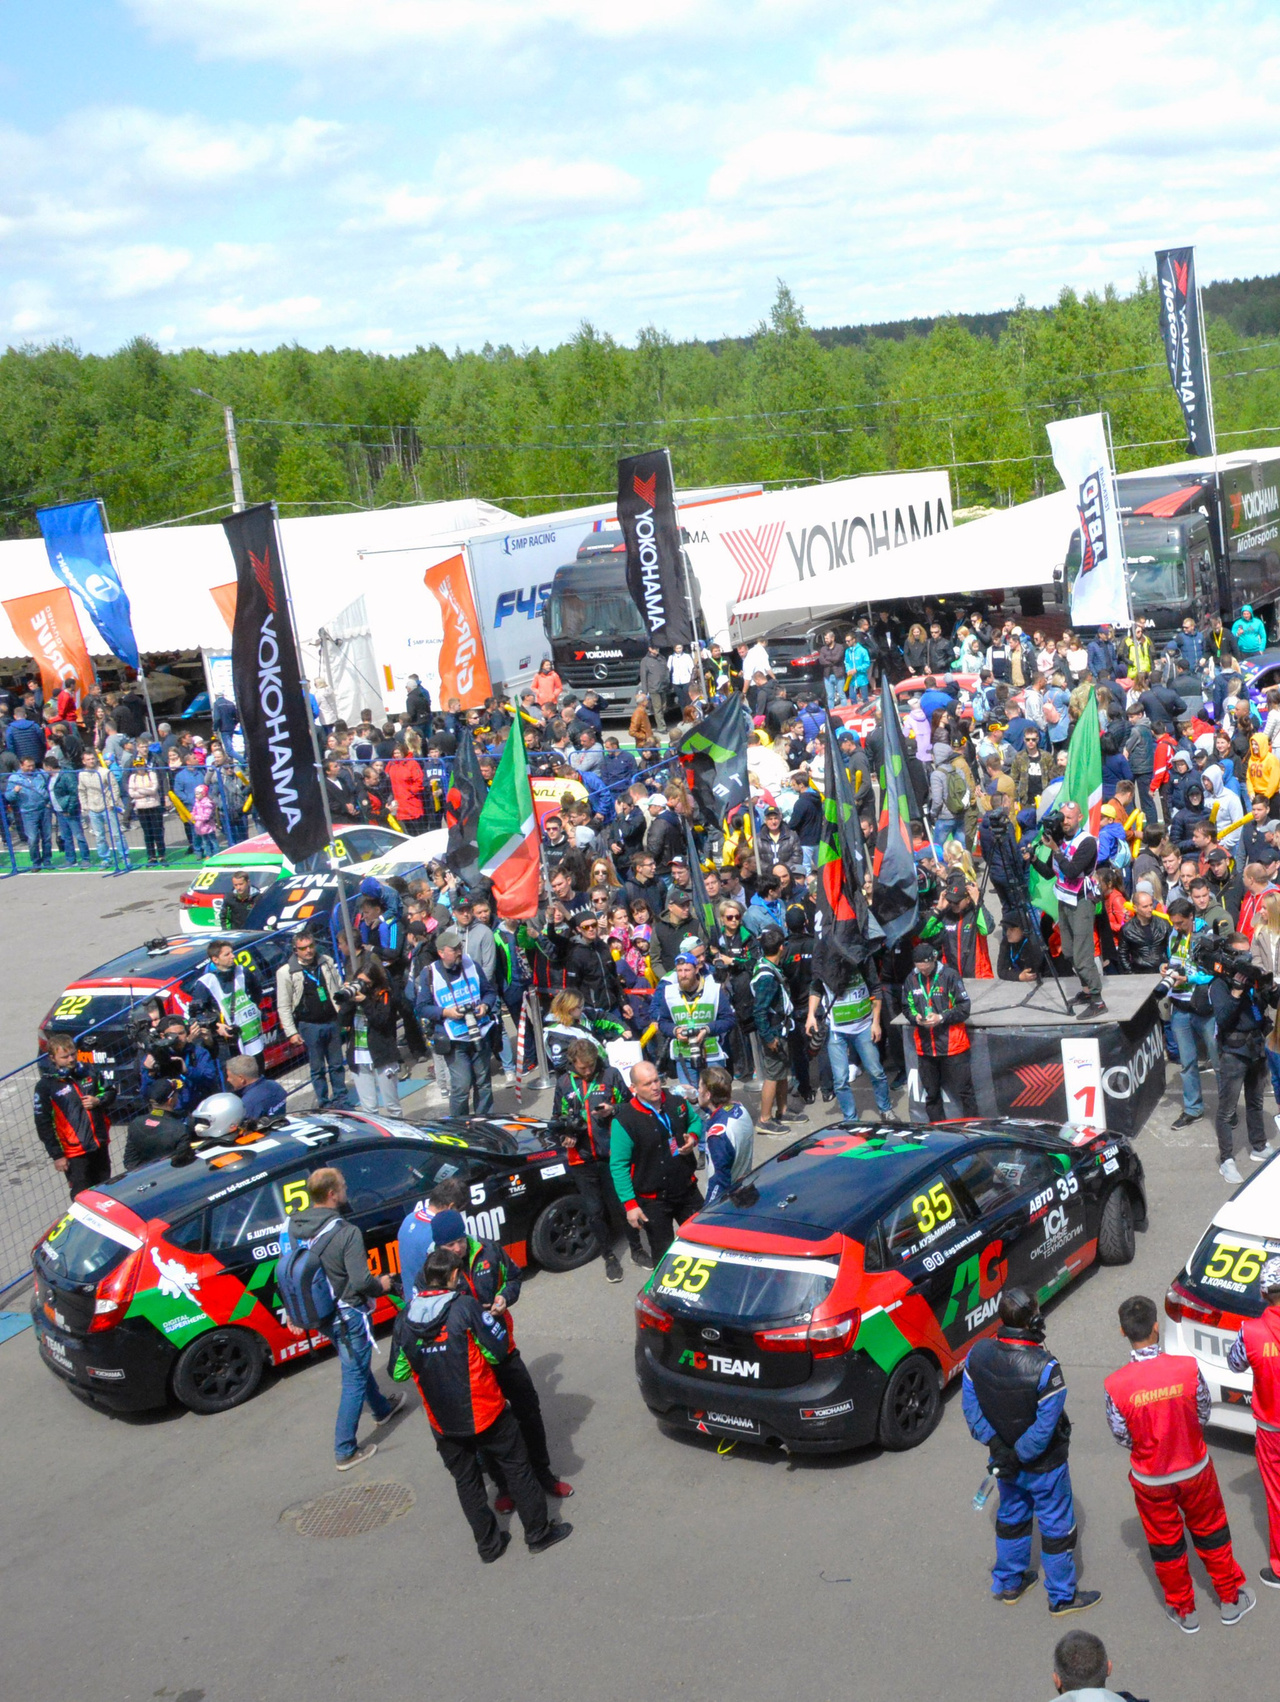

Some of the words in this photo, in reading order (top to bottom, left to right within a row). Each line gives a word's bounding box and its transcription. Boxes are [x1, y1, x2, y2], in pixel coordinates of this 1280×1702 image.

[1241, 486, 1279, 521] YOKOHAMA
[511, 537, 528, 550] SMP
[528, 532, 556, 548] RACING
[786, 498, 949, 581] YOKOHAMA
[1237, 525, 1279, 554] Motorsports
[634, 508, 666, 632] YOKOHAMA
[258, 612, 302, 834] YOKOHAMA
[194, 871, 219, 887] 18
[54, 995, 92, 1016] 22
[440, 984, 477, 1004] ПРЕССА
[852, 987, 866, 999] 127
[242, 1008, 257, 1019] 162
[674, 1010, 713, 1021] ПРЕССА
[1074, 1086, 1096, 1117] 1
[1103, 1145, 1119, 1159] TEAM
[283, 1180, 310, 1215] 5
[470, 1183, 486, 1205] 5
[509, 1184, 526, 1193] TMZ
[1056, 1171, 1078, 1201] 35
[912, 1182, 952, 1234] 35
[1029, 1187, 1053, 1215] АВТО
[919, 1218, 957, 1249] КУЗЬМИНОВ
[1030, 1227, 1068, 1259] СИСТЕМНЫЕ
[1043, 1224, 1083, 1259] ТЕХНОЛОГИИ
[661, 1254, 717, 1293] 35
[1205, 1244, 1268, 1284] 56
[1201, 1274, 1248, 1293] В.КОРАБЛЁВ
[163, 1314, 189, 1328] DIGITAL
[165, 1313, 206, 1334] SUPERHERO
[678, 1350, 707, 1370] AG
[708, 1355, 760, 1379] TEAM
[1134, 1384, 1183, 1406] AKHMAT
[707, 1411, 753, 1428] YOKOHAMA
[814, 1403, 851, 1417] YOKOHAMA
